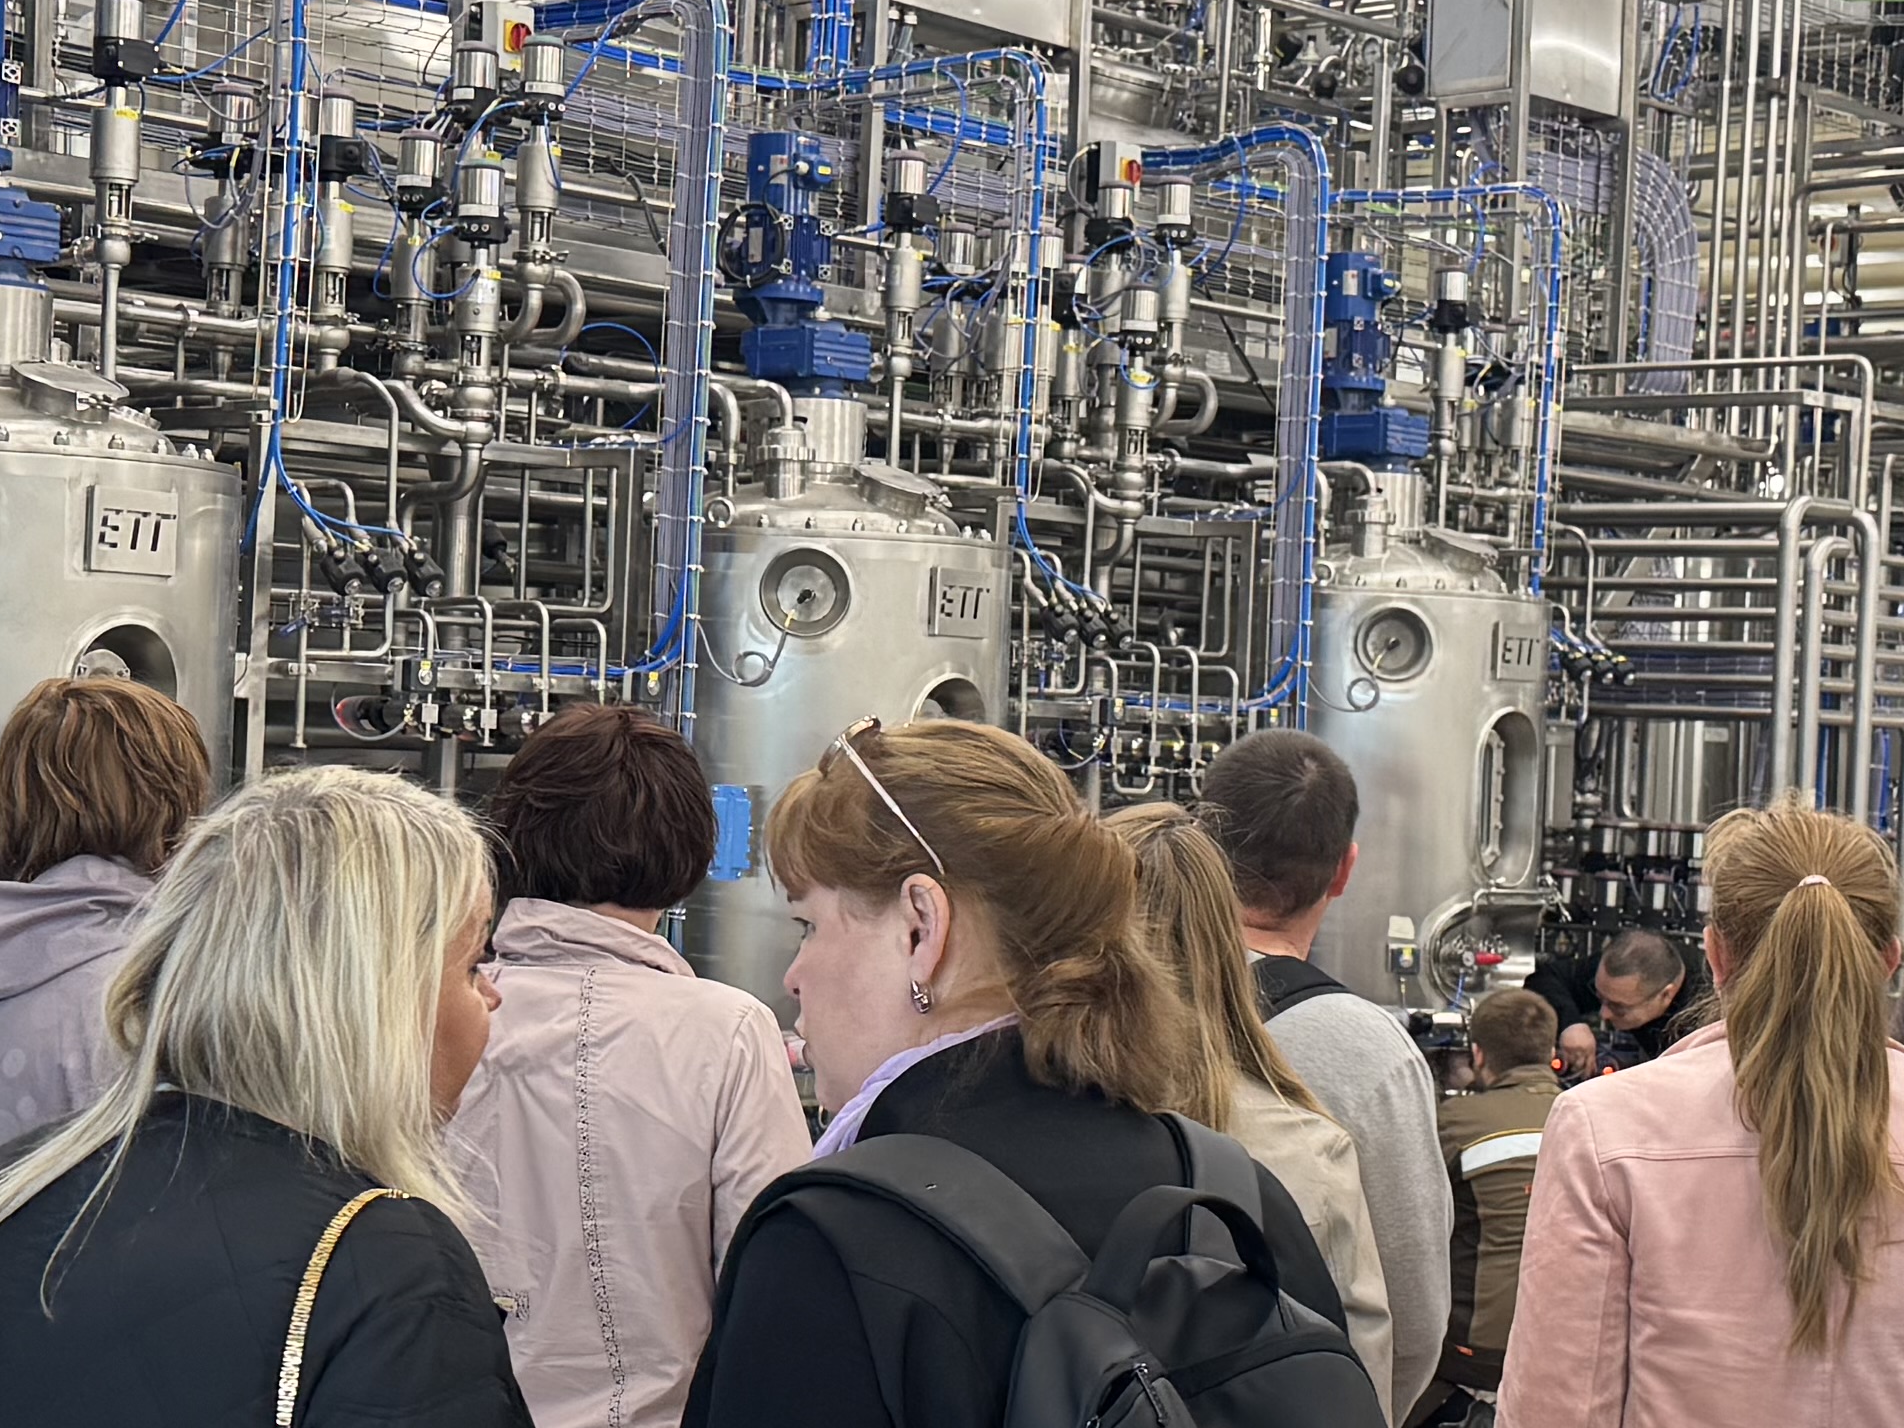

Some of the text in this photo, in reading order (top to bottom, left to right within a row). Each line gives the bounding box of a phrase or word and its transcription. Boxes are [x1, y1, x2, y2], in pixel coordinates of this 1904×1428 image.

[98, 507, 176, 552] ETT
[940, 584, 990, 620] ETT
[1502, 636, 1539, 666] ETT
